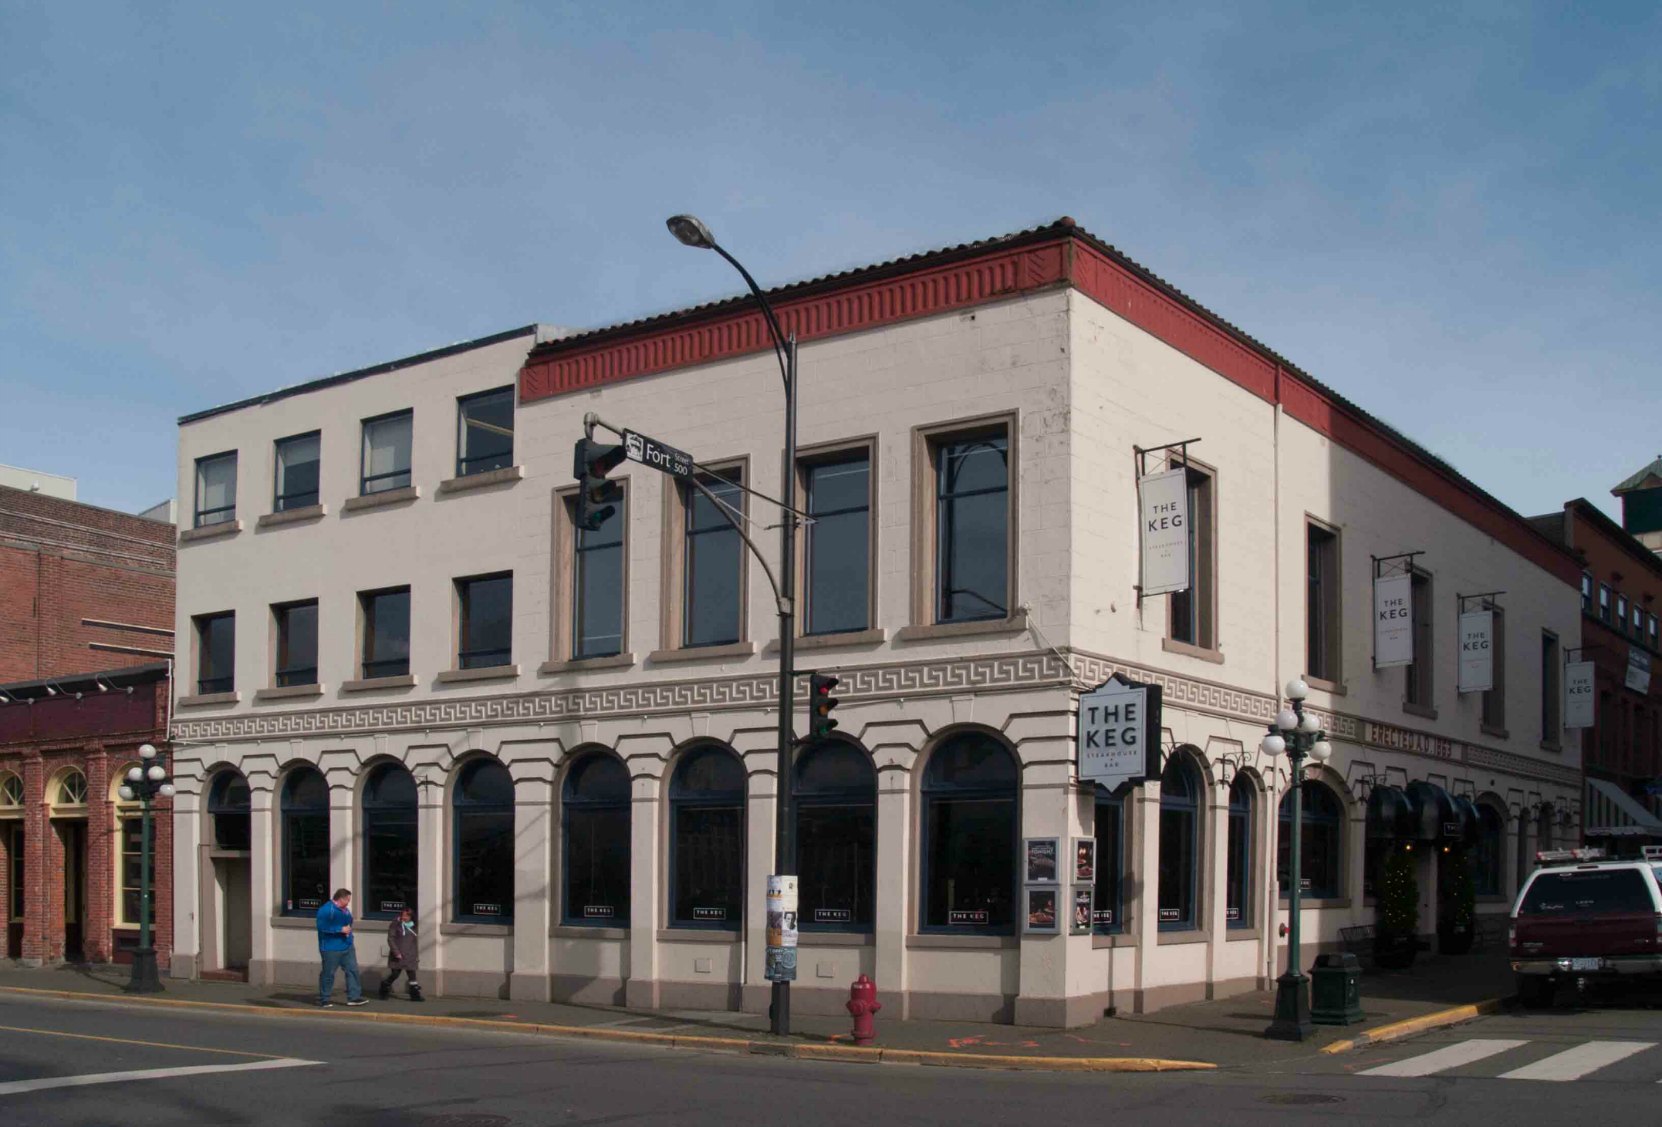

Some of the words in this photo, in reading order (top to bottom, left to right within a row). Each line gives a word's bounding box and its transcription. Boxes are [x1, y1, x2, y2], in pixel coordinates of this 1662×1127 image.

[646, 443, 671, 468] Fort
[674, 463, 688, 476] 500
[1153, 502, 1177, 514] THE
[1148, 514, 1183, 532] KEG
[1384, 598, 1403, 607] THE
[1380, 607, 1408, 621] KEG
[1467, 632, 1485, 640] THE
[1463, 640, 1489, 651] KEG
[1088, 703, 1137, 725] THE
[1086, 727, 1137, 749] KEG
[1371, 722, 1414, 750] ERECTED
